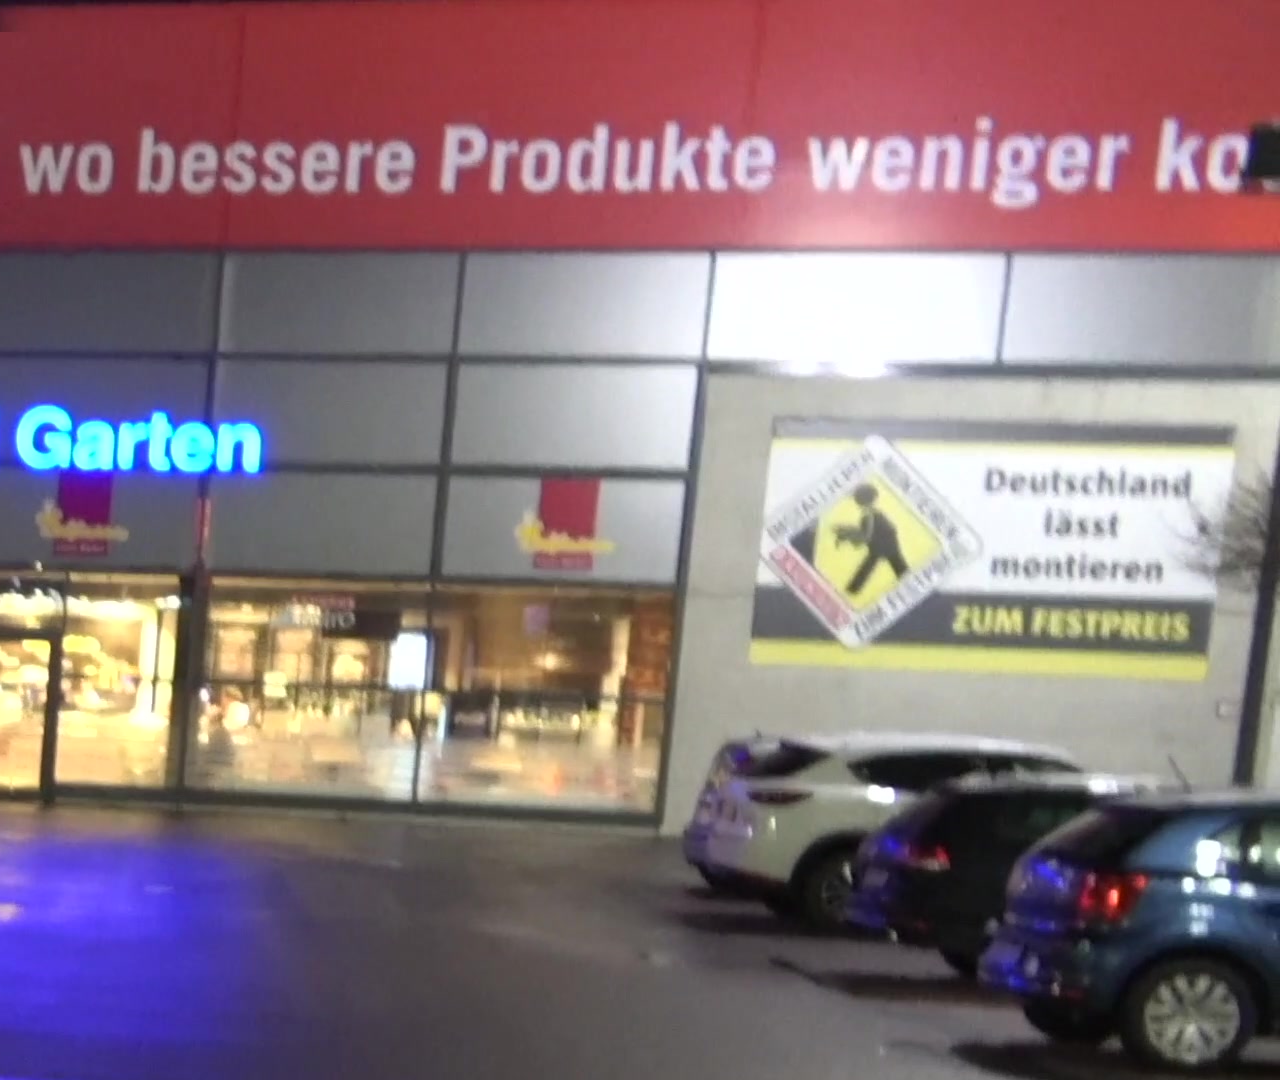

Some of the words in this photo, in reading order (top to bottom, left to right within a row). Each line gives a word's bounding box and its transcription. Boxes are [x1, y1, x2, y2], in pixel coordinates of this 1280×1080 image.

[20, 142, 114, 195] wo
[138, 126, 416, 195] bessere
[439, 122, 776, 193] Produkte
[808, 116, 1129, 209] weniger
[1154, 117, 1278, 194] ko
[16, 404, 263, 474] Garten
[984, 466, 1193, 500] Deutschland
[1042, 507, 1120, 539] lässt
[989, 553, 1164, 584] montieren
[952, 605, 1024, 637] ZUM
[1030, 607, 1192, 643] FESTPREIS
